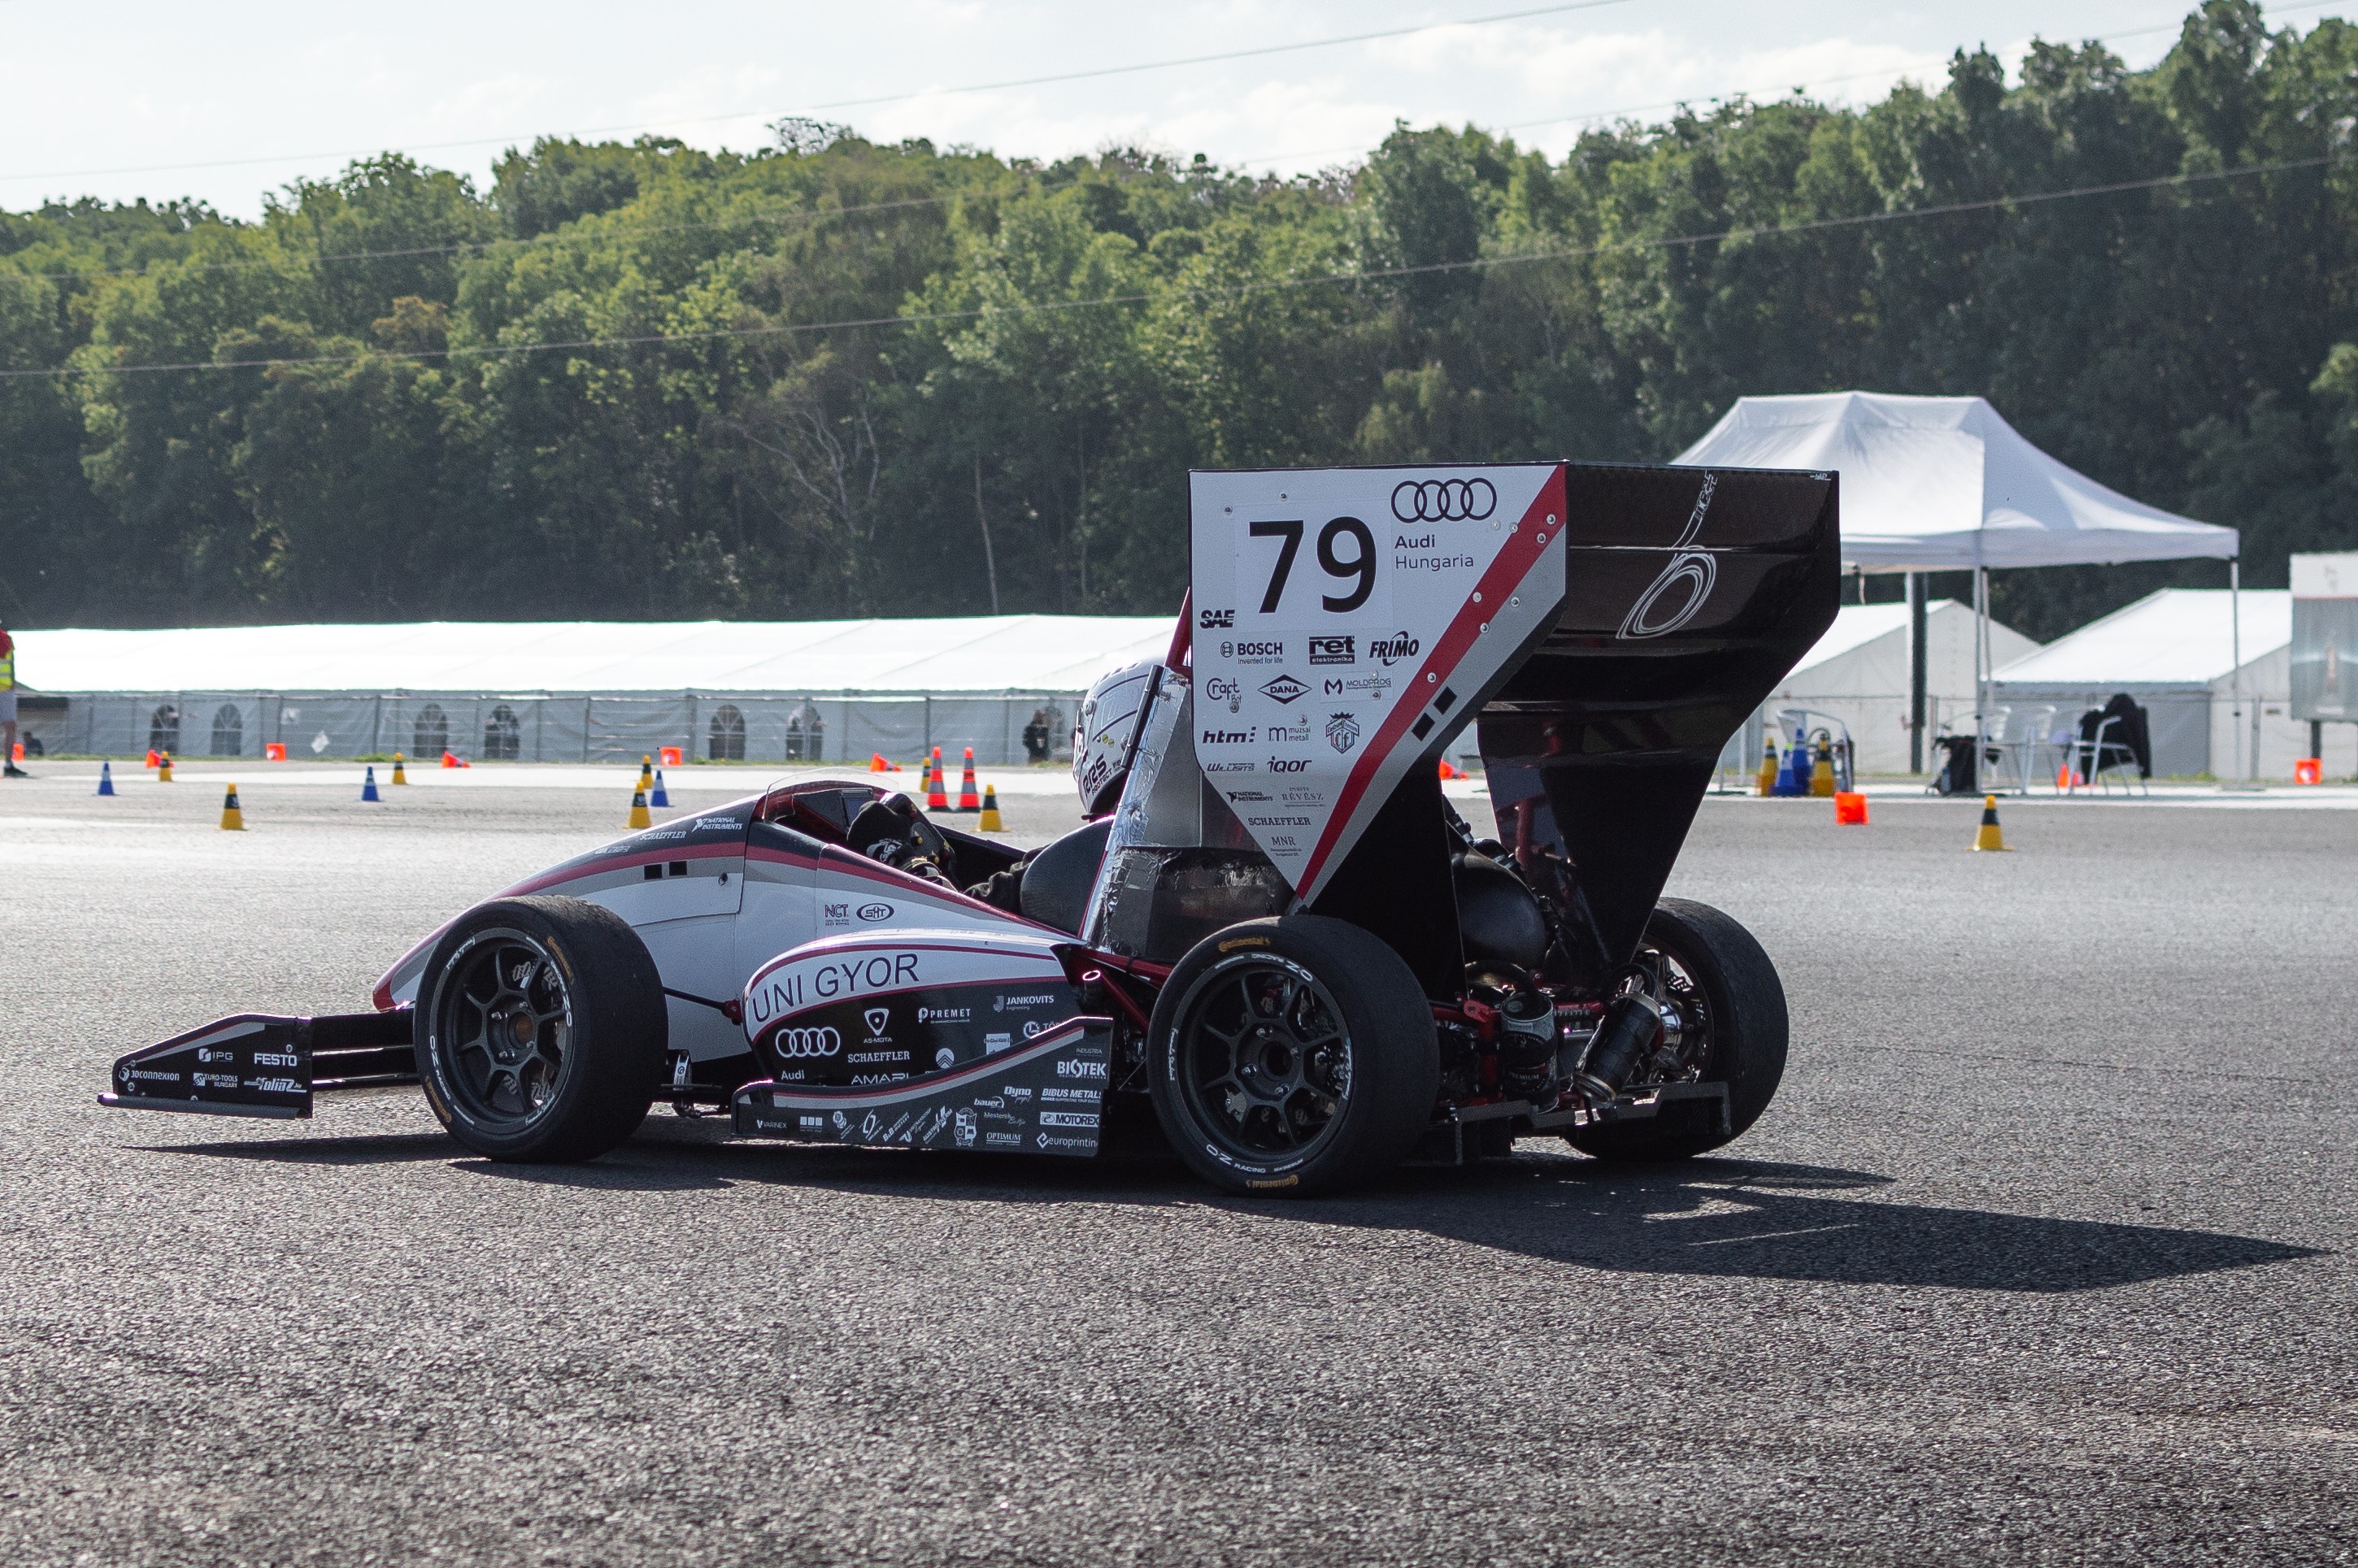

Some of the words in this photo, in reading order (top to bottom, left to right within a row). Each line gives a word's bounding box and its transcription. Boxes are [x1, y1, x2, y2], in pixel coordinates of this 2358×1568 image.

[1394, 534, 1435, 549] Audi
[1250, 516, 1377, 613] 79
[1395, 554, 1474, 571] Hungaria
[1199, 610, 1235, 628] SAE
[1238, 642, 1283, 655] BOSCH
[1309, 636, 1355, 654] ret
[1369, 639, 1419, 658] FRIMO
[1248, 817, 1311, 826] SCHAEFFLER
[639, 831, 686, 840] SCHAEFFLER
[1271, 836, 1296, 846] MNR
[752, 975, 803, 1023] UNI
[1007, 996, 1055, 1005] JANKOVITS
[930, 1009, 971, 1018] PREMET
[212, 1052, 233, 1061] IPG
[255, 1053, 298, 1066] FESTO
[848, 1051, 910, 1063] SCHAEFFLER
[781, 1070, 805, 1079] Audi
[1004, 1086, 1031, 1097] Dyno
[974, 1098, 1000, 1107] bauer
[986, 1132, 1021, 1140] OPTIMUM
